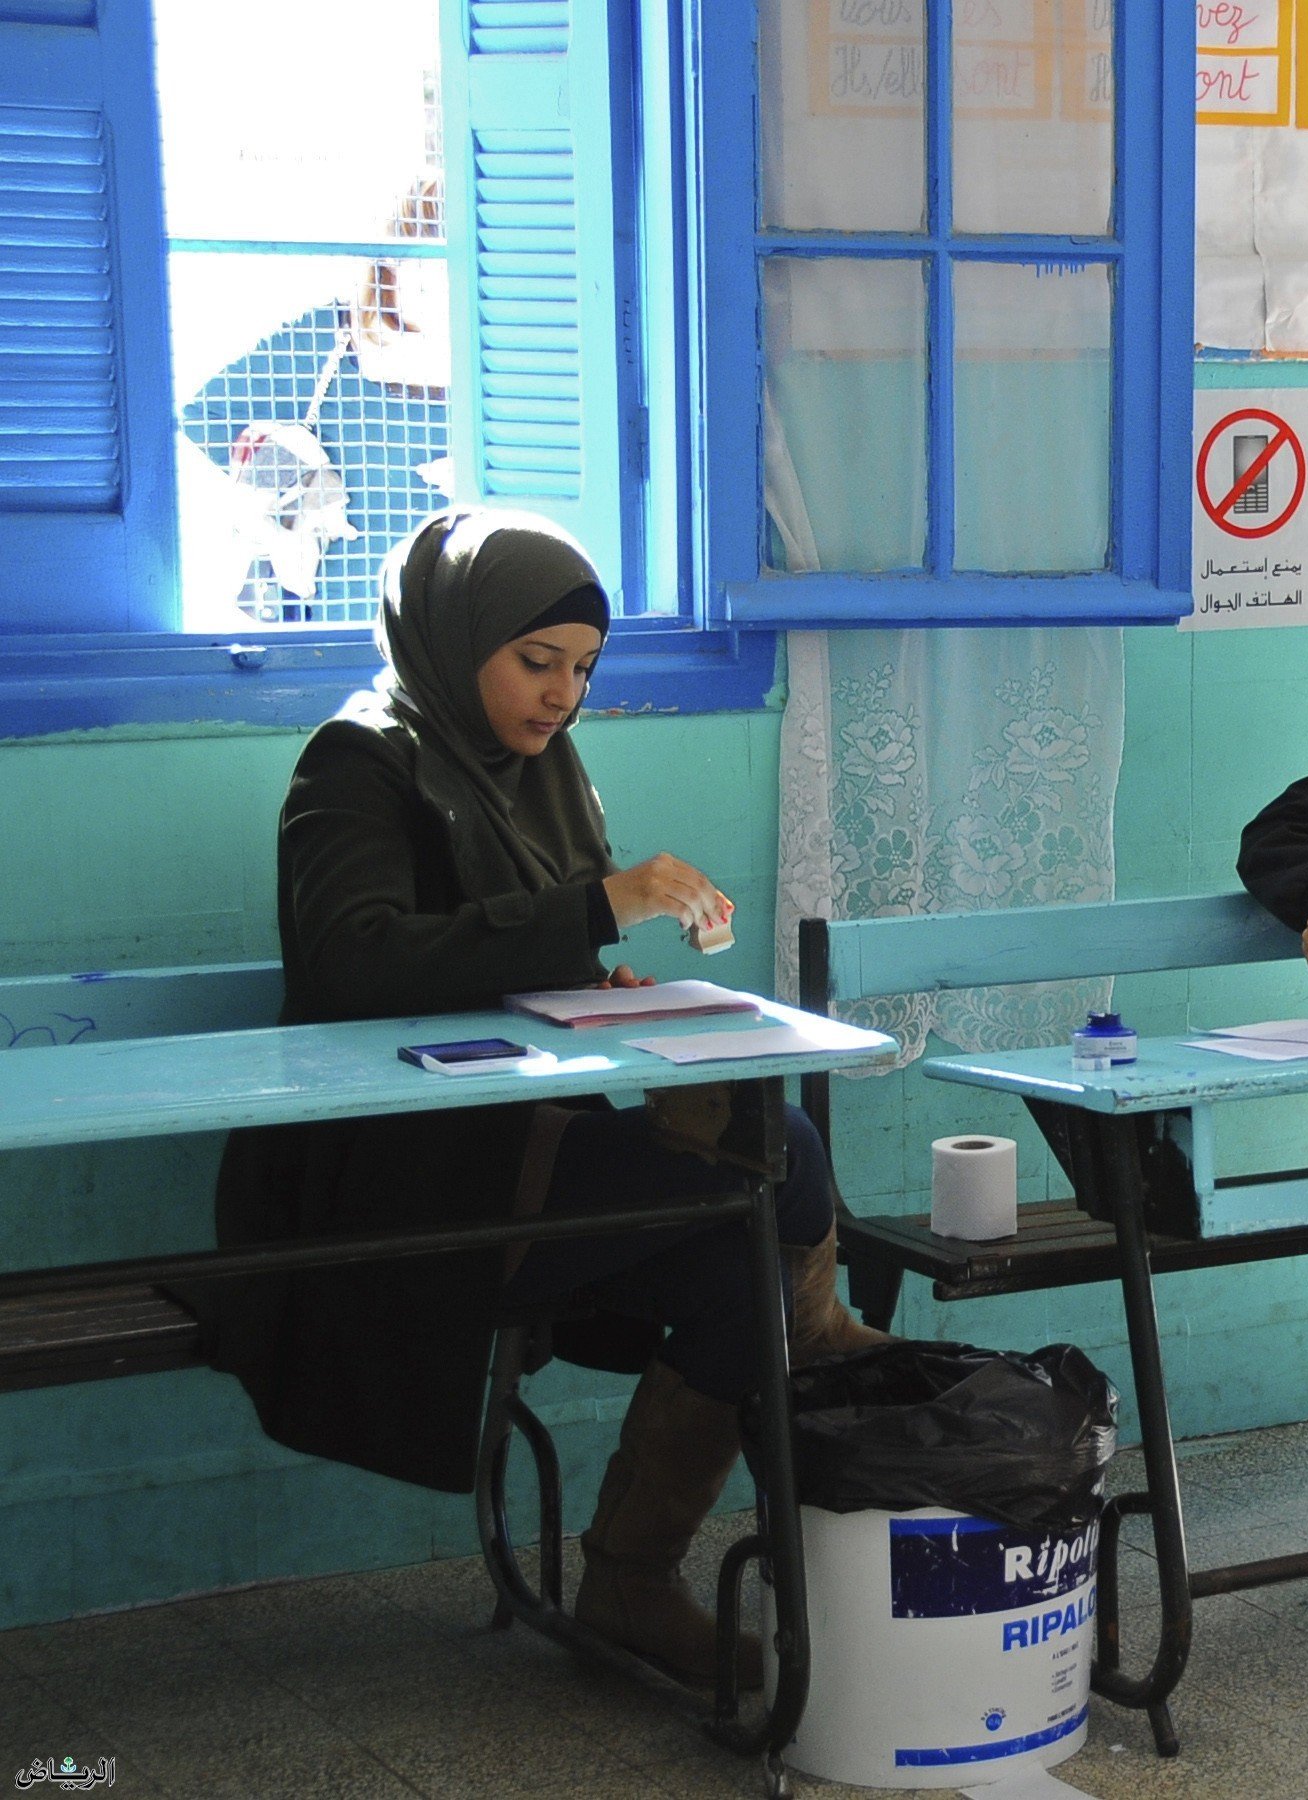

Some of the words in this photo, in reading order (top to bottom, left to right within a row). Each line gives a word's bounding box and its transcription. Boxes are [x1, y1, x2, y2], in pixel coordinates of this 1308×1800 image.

[1196, 2, 1259, 44] vez
[1196, 59, 1259, 101] ont
[1201, 558, 1268, 580] إستعمال
[1271, 559, 1302, 577] يمنع
[1201, 592, 1241, 614] الجوال
[1246, 589, 1302, 607] الهاتف
